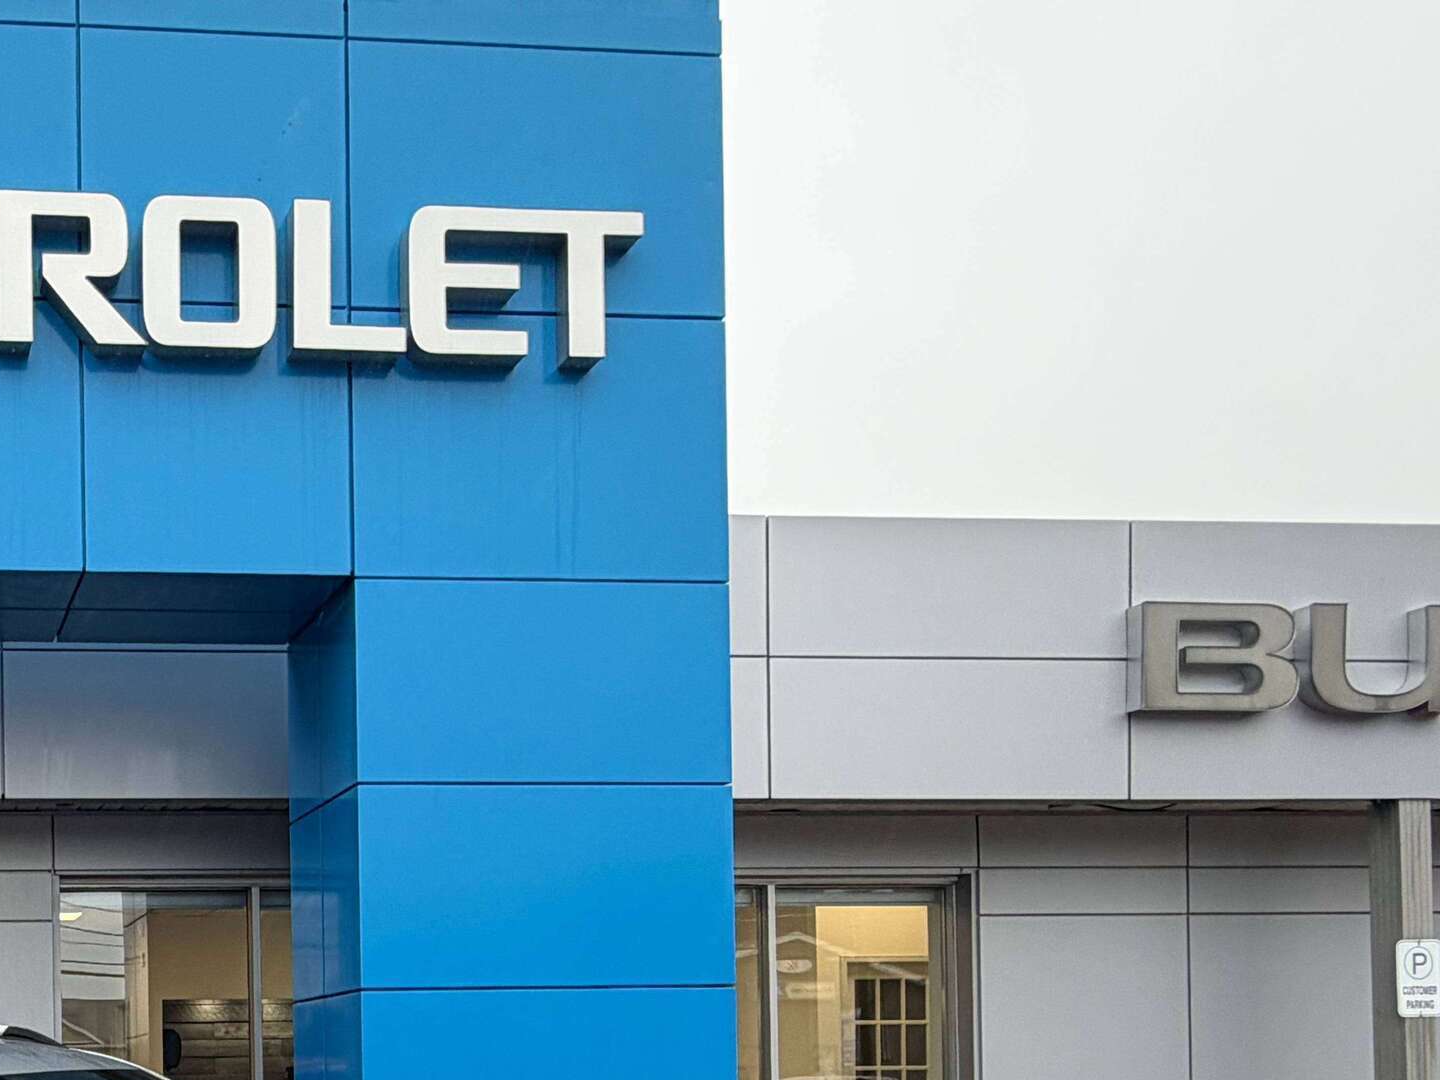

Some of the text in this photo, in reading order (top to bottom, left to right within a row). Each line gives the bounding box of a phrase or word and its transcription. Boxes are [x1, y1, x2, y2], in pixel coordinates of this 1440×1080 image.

[1412, 952, 1427, 975] P
[1403, 986, 1438, 995] CUSTOMER
[1406, 1000, 1435, 1009] PARKING
